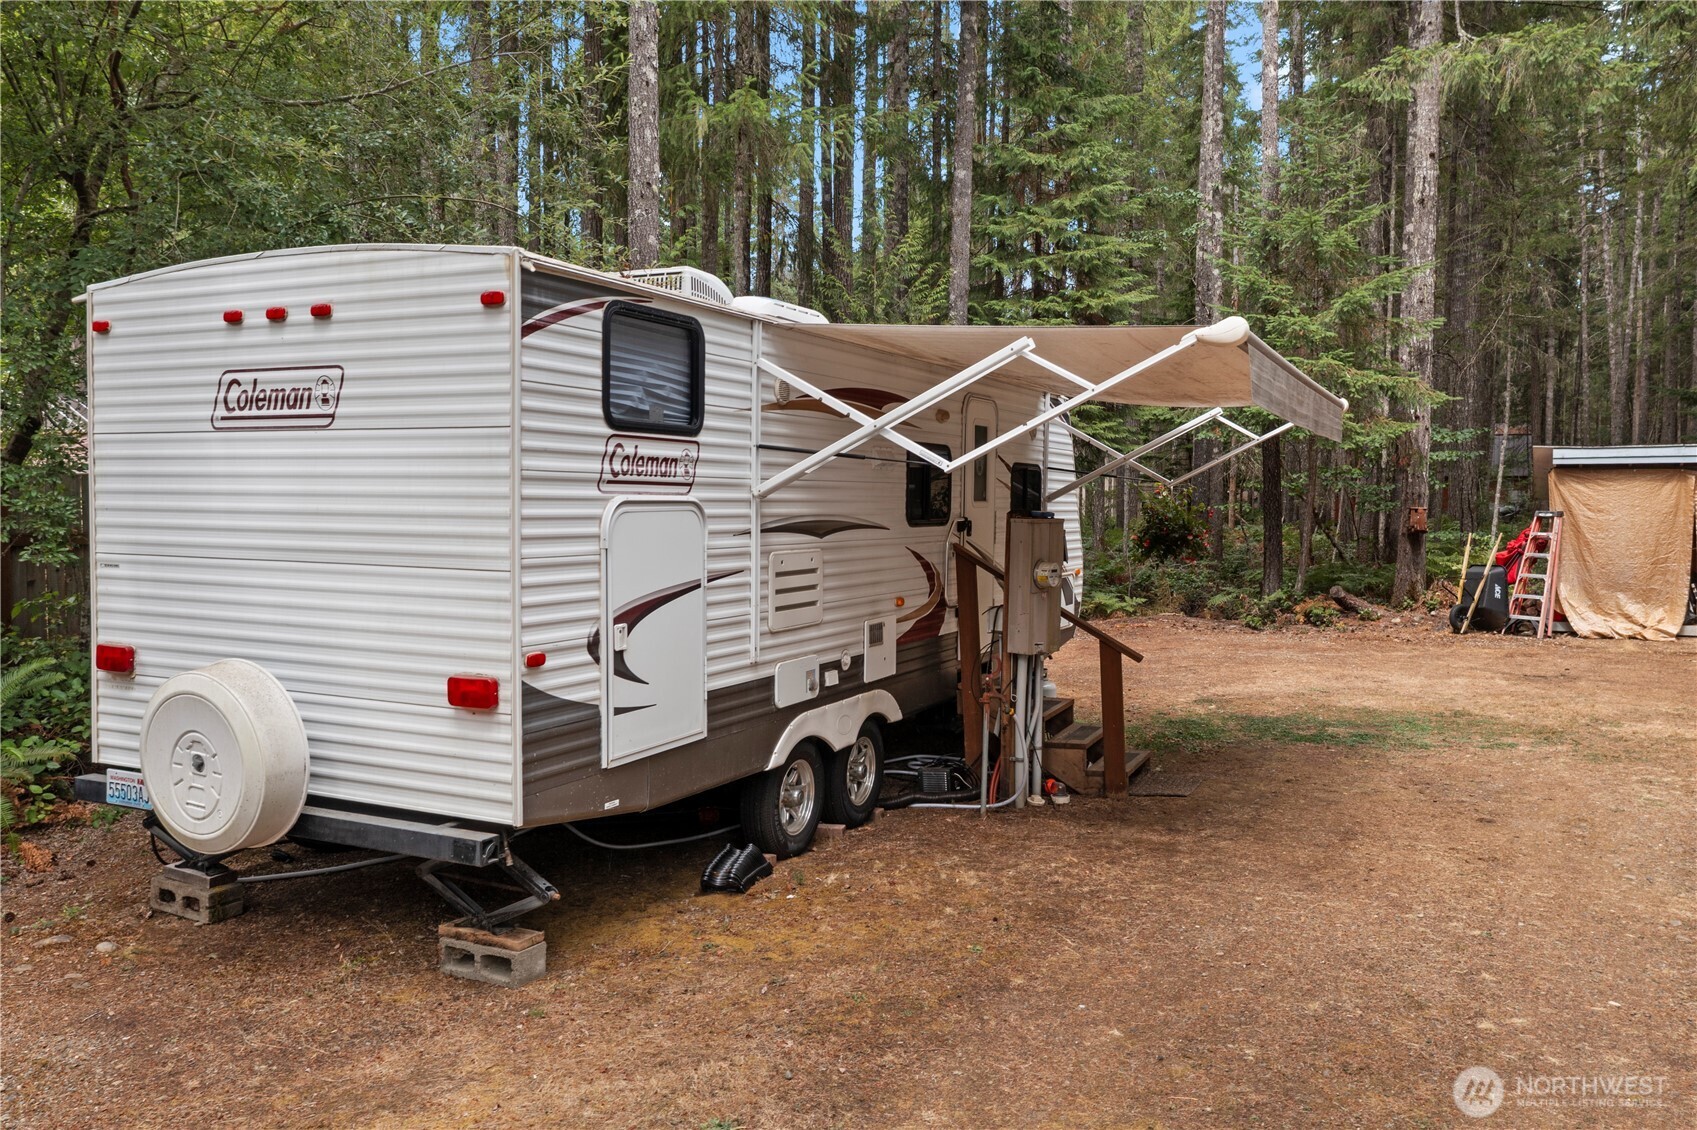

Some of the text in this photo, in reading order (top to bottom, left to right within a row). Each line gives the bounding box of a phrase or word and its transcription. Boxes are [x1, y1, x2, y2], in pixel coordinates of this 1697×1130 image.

[223, 378, 313, 414] Coleman
[609, 442, 679, 478] Coleman
[1494, 583, 1502, 599] ACE
